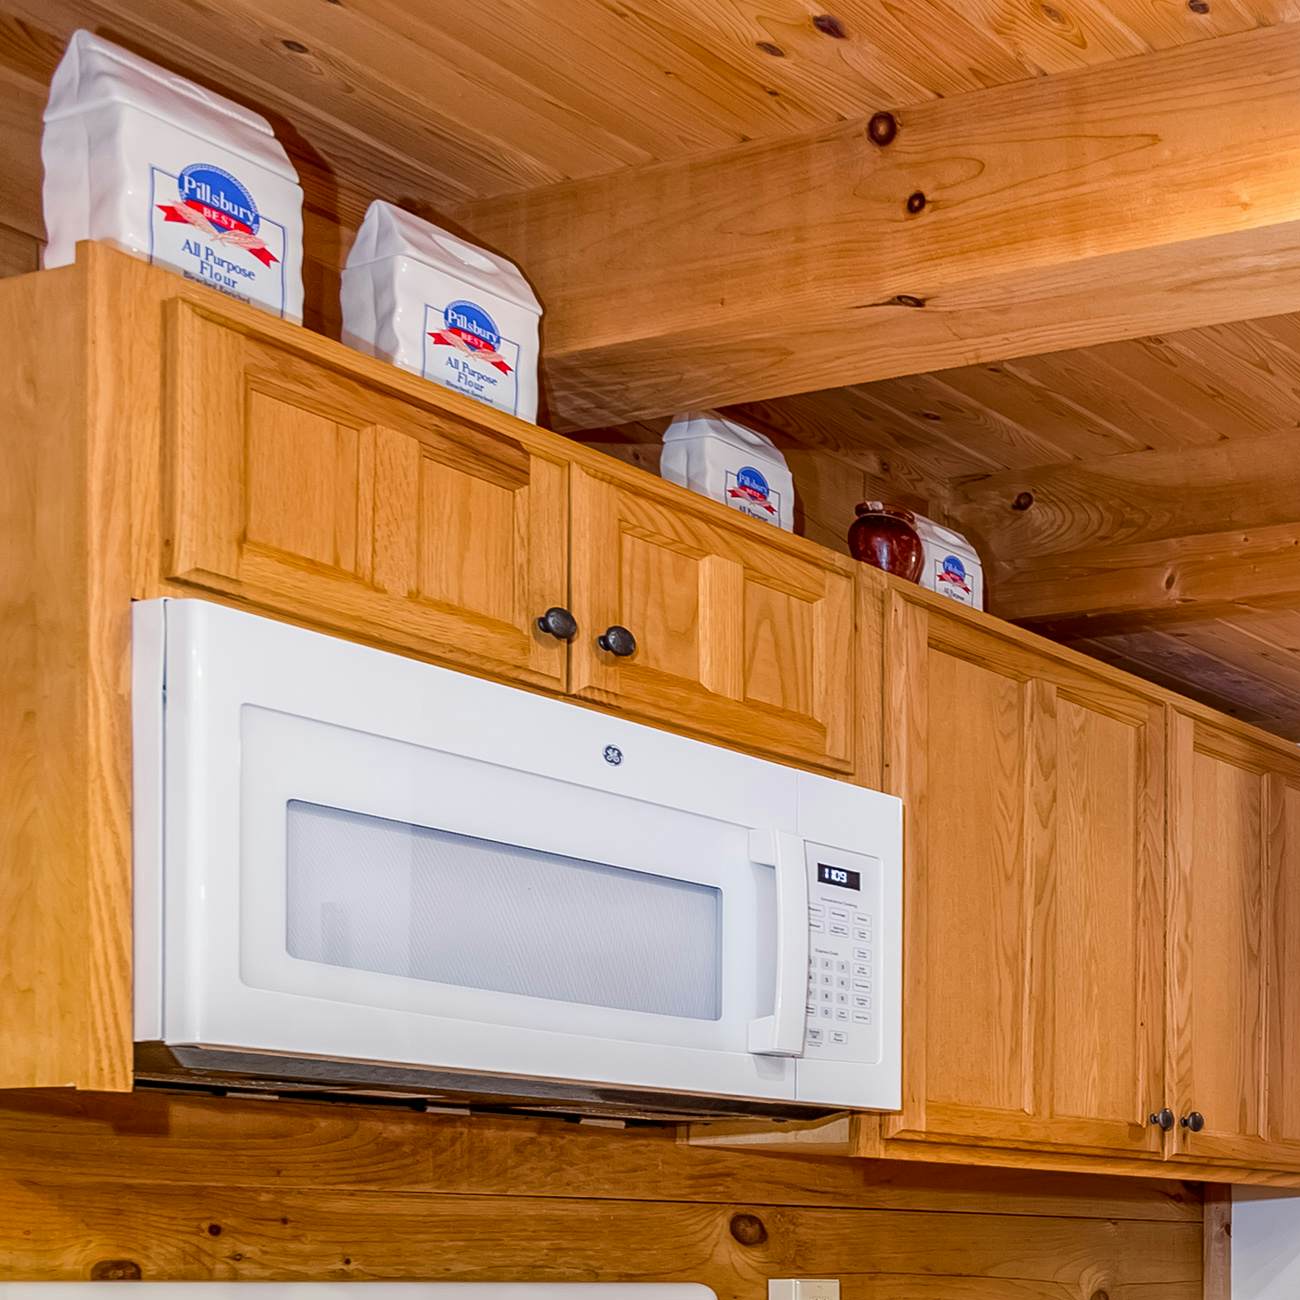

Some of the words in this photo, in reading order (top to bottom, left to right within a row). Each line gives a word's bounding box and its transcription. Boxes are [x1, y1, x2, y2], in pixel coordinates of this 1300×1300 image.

[183, 175, 256, 225] Pillsbury
[203, 207, 236, 228] BEST
[181, 239, 200, 258] All
[205, 246, 256, 282] Purpose
[200, 260, 238, 289] Flour
[447, 309, 498, 343] Pillsbury
[461, 331, 484, 348] BEST
[447, 356, 459, 370] All
[462, 361, 498, 386] Purpose
[458, 372, 485, 392] Flour
